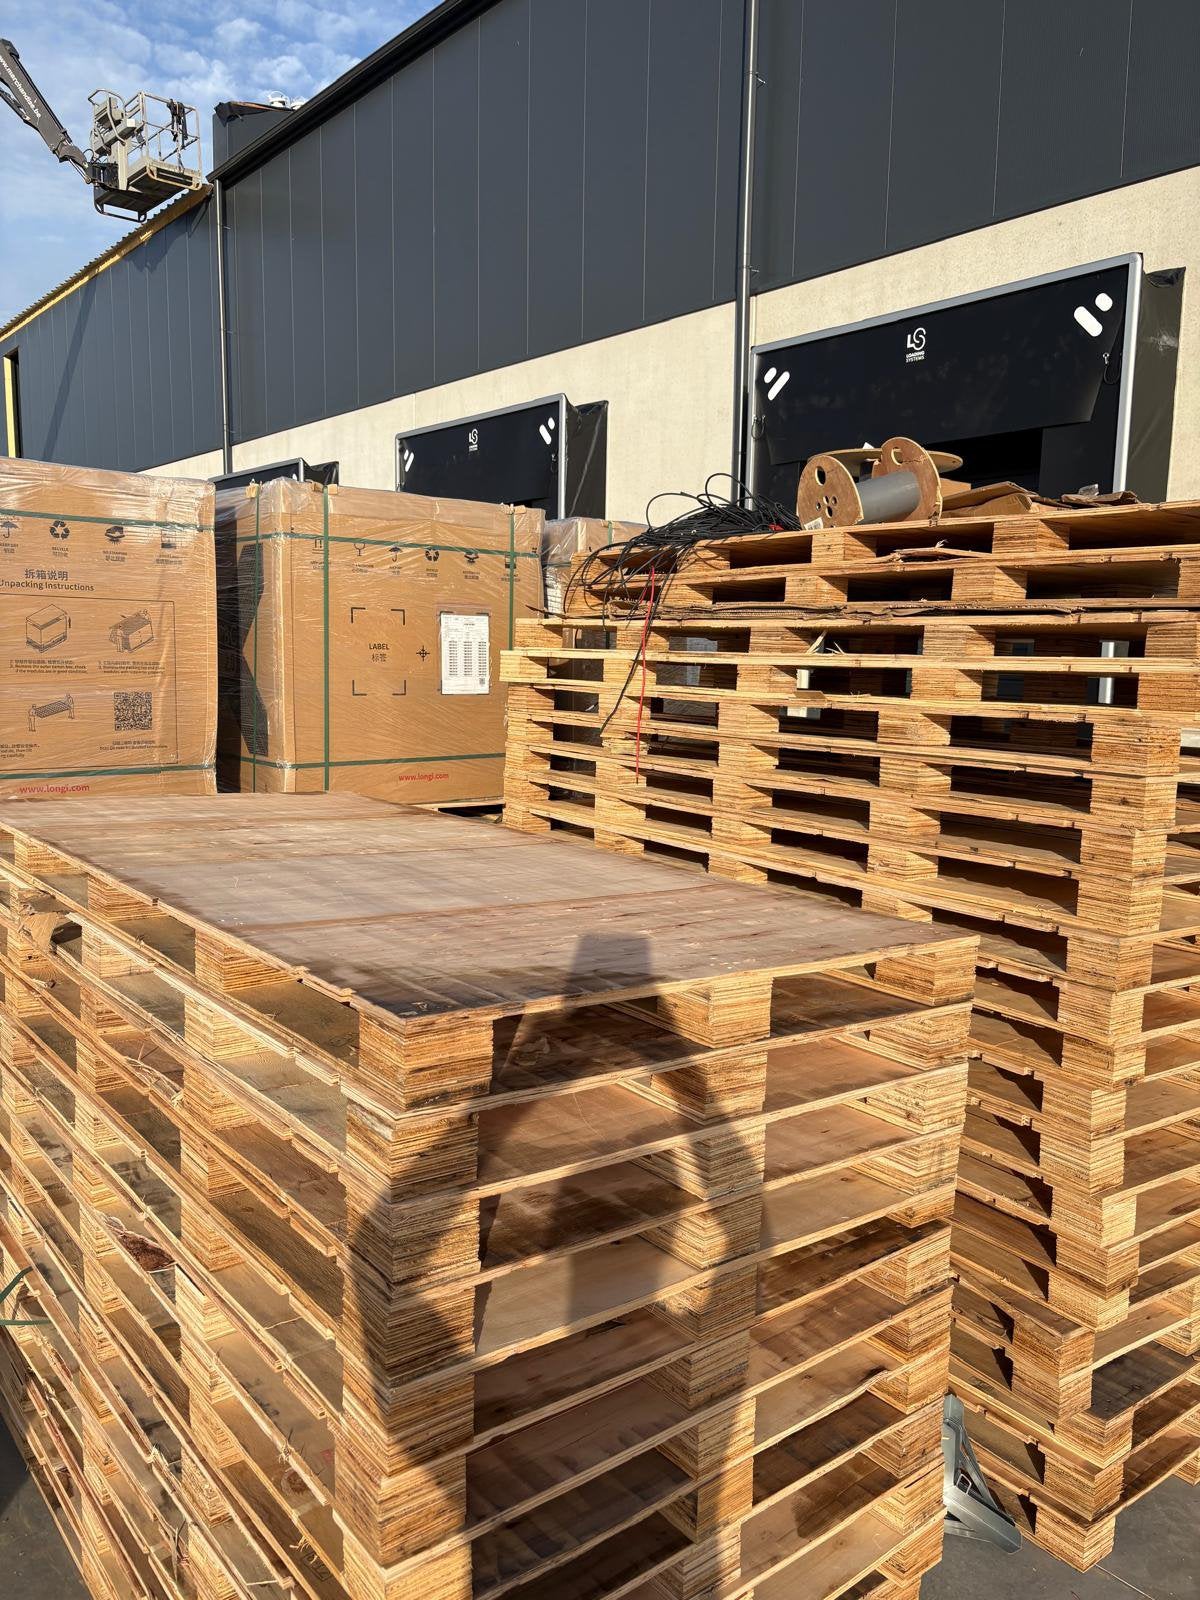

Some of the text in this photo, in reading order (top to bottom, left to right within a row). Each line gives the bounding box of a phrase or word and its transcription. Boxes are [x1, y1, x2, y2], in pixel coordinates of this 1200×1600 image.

[24, 568, 68, 581] 拆箱说明
[45, 581, 95, 591] Instructions
[399, 772, 449, 782] www.longi.com
[17, 784, 90, 794] www.longi.com
